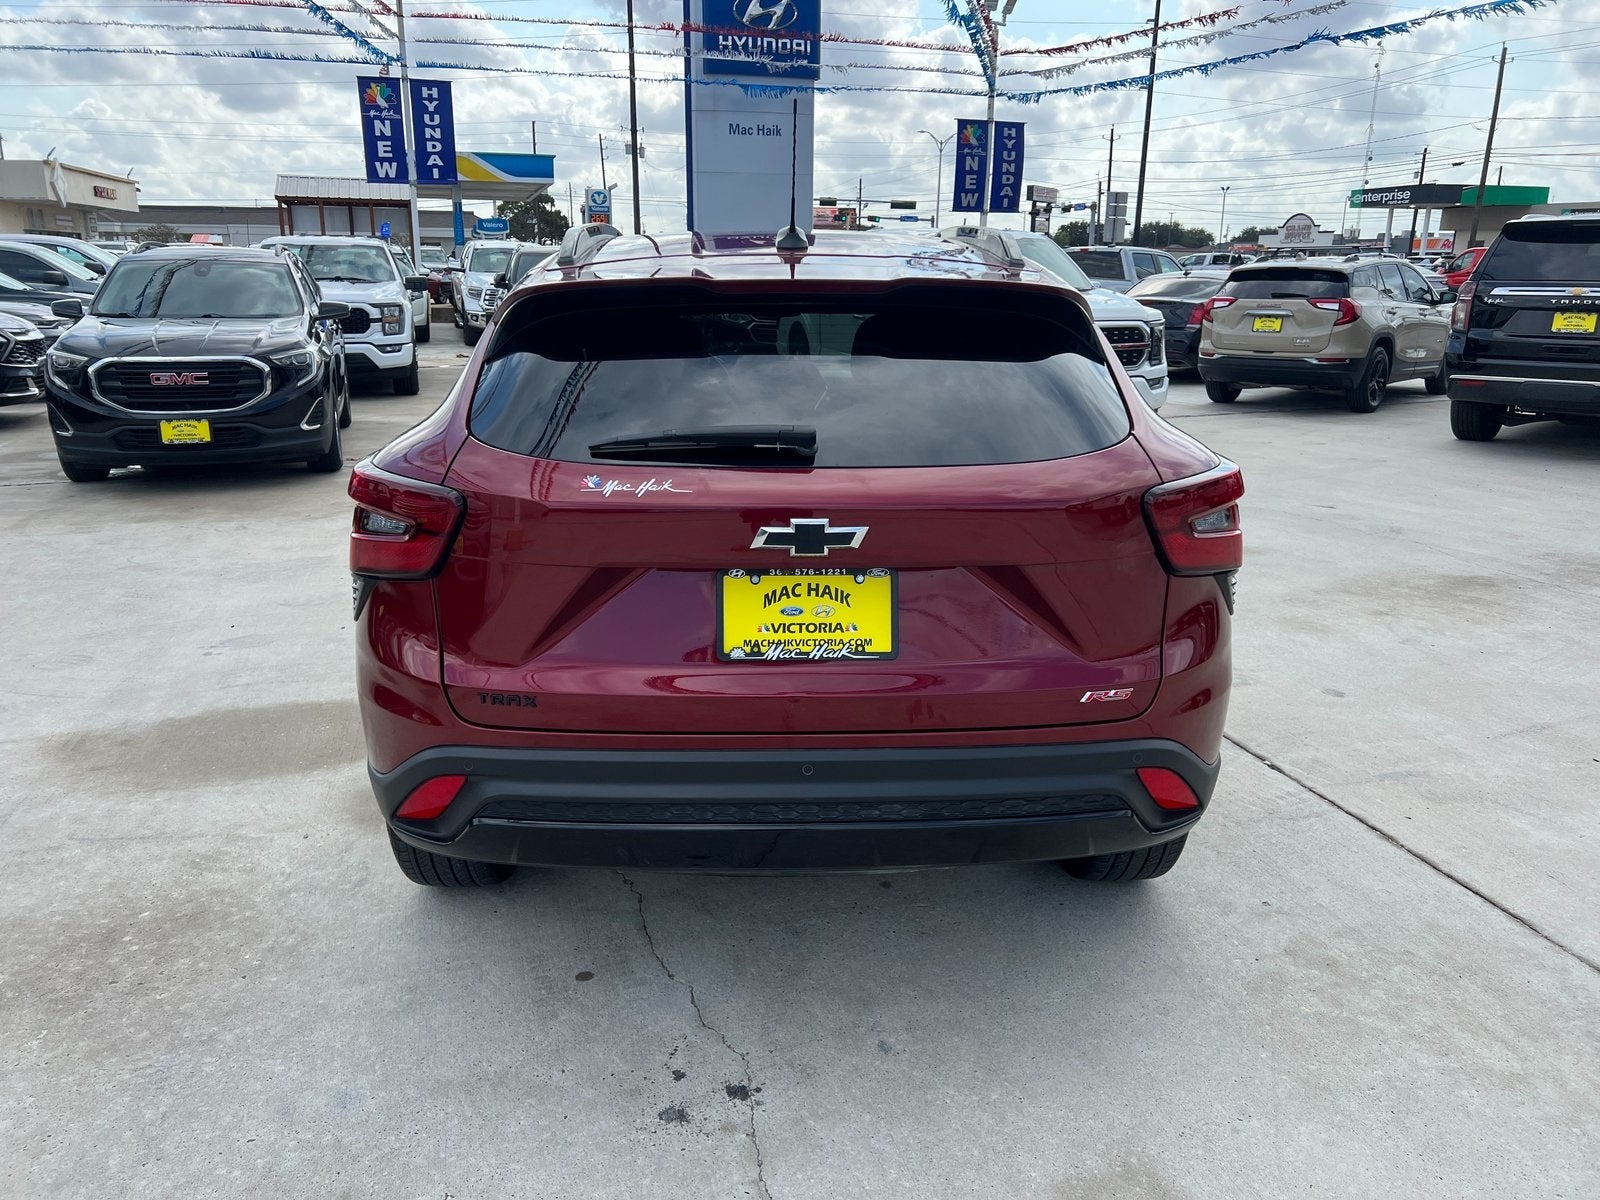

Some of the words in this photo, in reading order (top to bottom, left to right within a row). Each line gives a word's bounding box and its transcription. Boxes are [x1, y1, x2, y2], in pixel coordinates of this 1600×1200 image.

[718, 35, 811, 55] HYUNDAI
[421, 86, 445, 179] HYUNDAI
[728, 123, 754, 136] Mac
[756, 124, 782, 137] Haik
[373, 119, 398, 178] NEW
[1000, 127, 1017, 208] HYUNDAI
[960, 156, 979, 207] NEW
[1349, 189, 1411, 204] enterprise
[150, 372, 209, 385] GMC
[600, 480, 635, 498] Mac
[635, 478, 677, 498] Haik
[769, 568, 847, 576] 36-576-1221
[763, 582, 802, 609] MAC
[806, 582, 852, 608] HAIK
[782, 606, 802, 616] Ford
[770, 622, 845, 634] VICTORIA
[743, 638, 873, 648] MACHAIKVICTORIACOM
[763, 643, 804, 660] Mac
[808, 642, 857, 660] Haik
[479, 692, 538, 708] TRAX
[1080, 687, 1134, 703] RS
